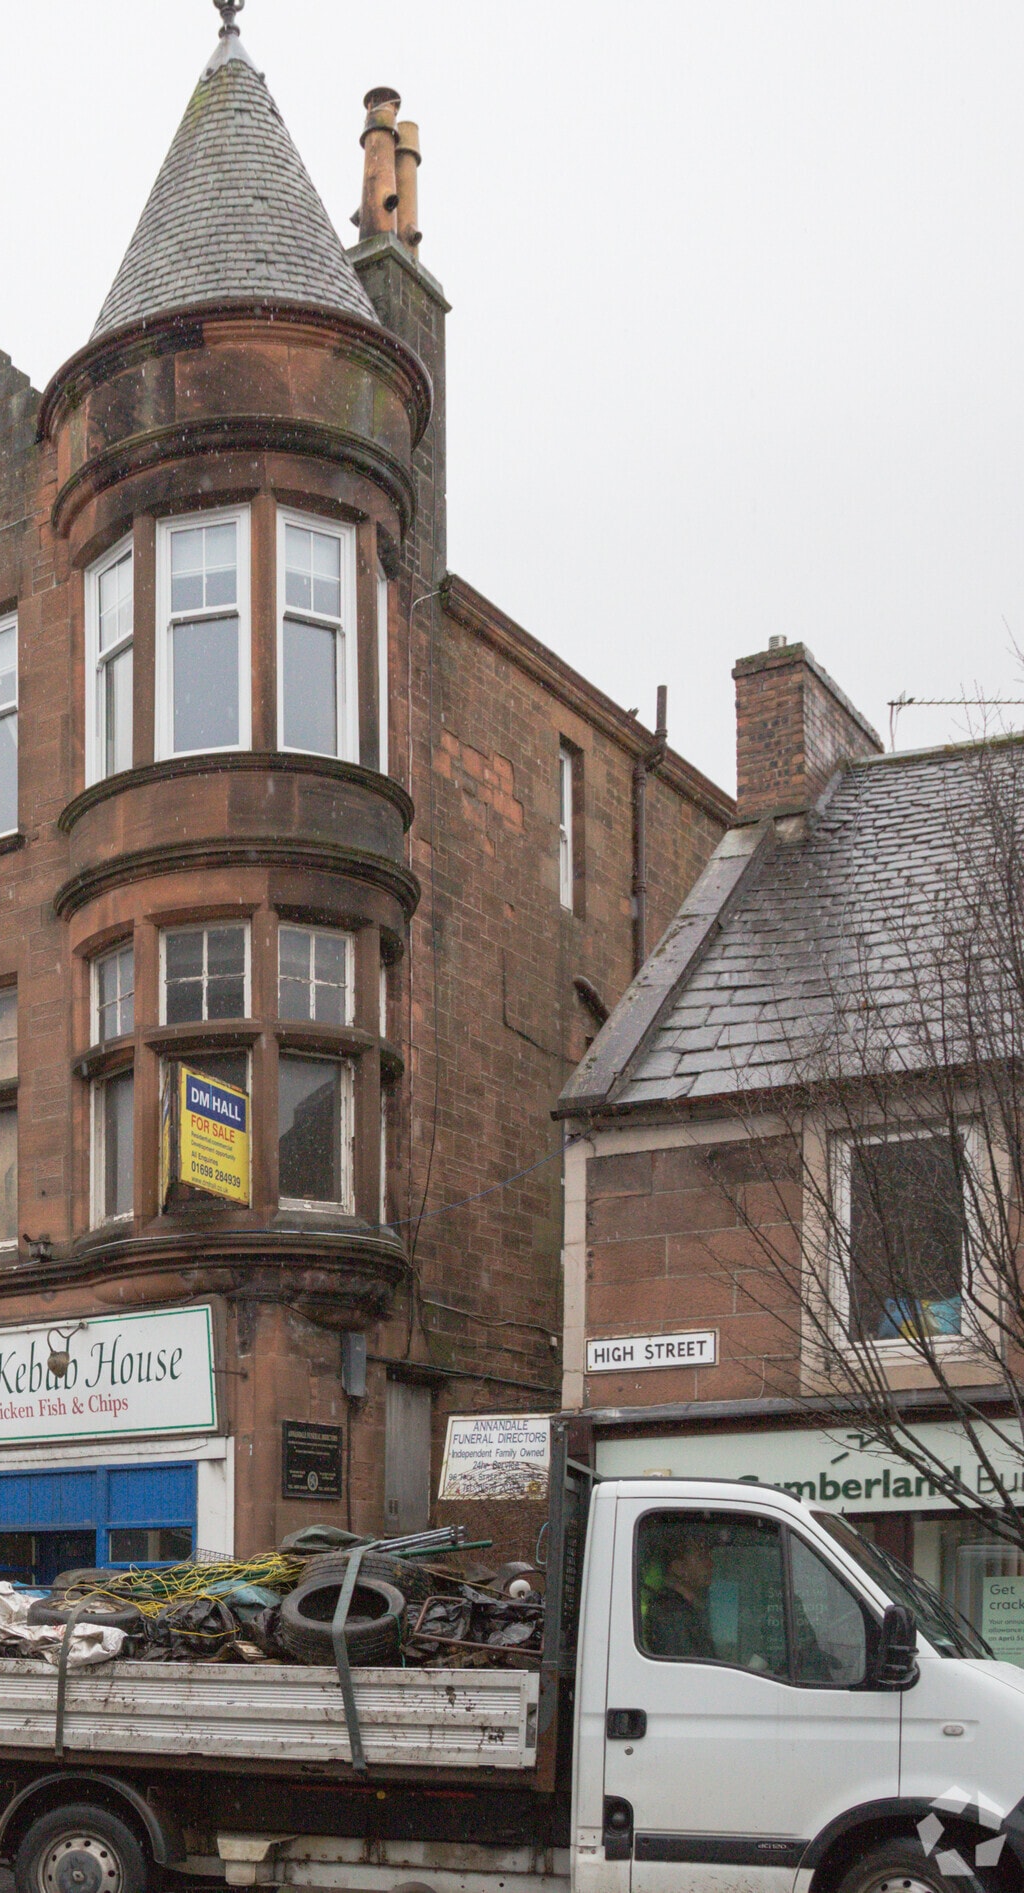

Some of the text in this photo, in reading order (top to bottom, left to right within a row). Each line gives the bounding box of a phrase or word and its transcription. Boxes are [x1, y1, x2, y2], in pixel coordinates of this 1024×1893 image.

[191, 1086, 242, 1122] DM HALL
[191, 1114, 236, 1144] FOR SALE
[191, 1160, 241, 1188] 01698 284939
[85, 1334, 183, 1388] House
[594, 1340, 707, 1364] HIGH STREET
[37, 1396, 67, 1417] Fish
[71, 1396, 85, 1414] &
[88, 1391, 129, 1418] Chips
[452, 1431, 547, 1445] FUNERAL DIRECTORS
[473, 1420, 529, 1432] ANNANDALE
[451, 1447, 545, 1460] Independent Family Owned
[989, 1584, 1016, 1595] Get
